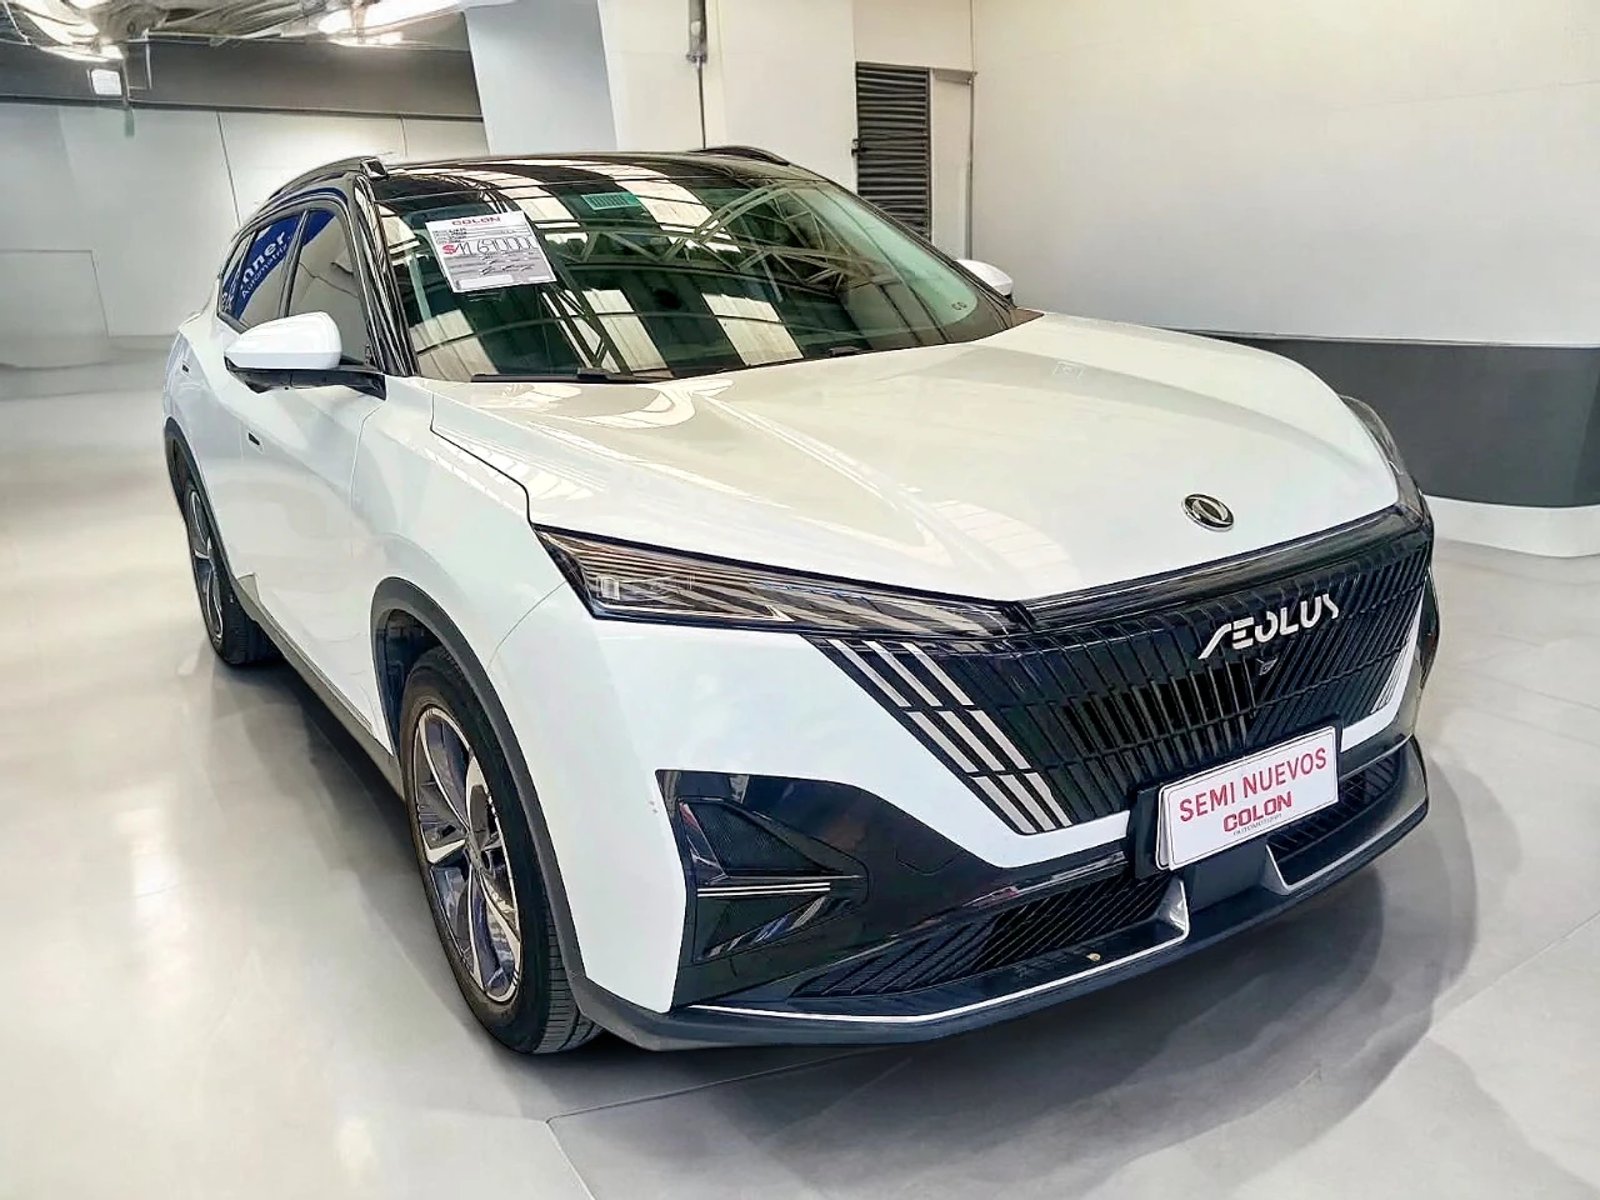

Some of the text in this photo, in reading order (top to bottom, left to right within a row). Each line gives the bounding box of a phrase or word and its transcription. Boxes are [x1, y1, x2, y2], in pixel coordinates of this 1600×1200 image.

[452, 216, 501, 226] COLON
[1198, 593, 1340, 660] AEOLUS
[1179, 747, 1327, 822] SEMI NUEVOS
[1223, 791, 1292, 832] COLON
